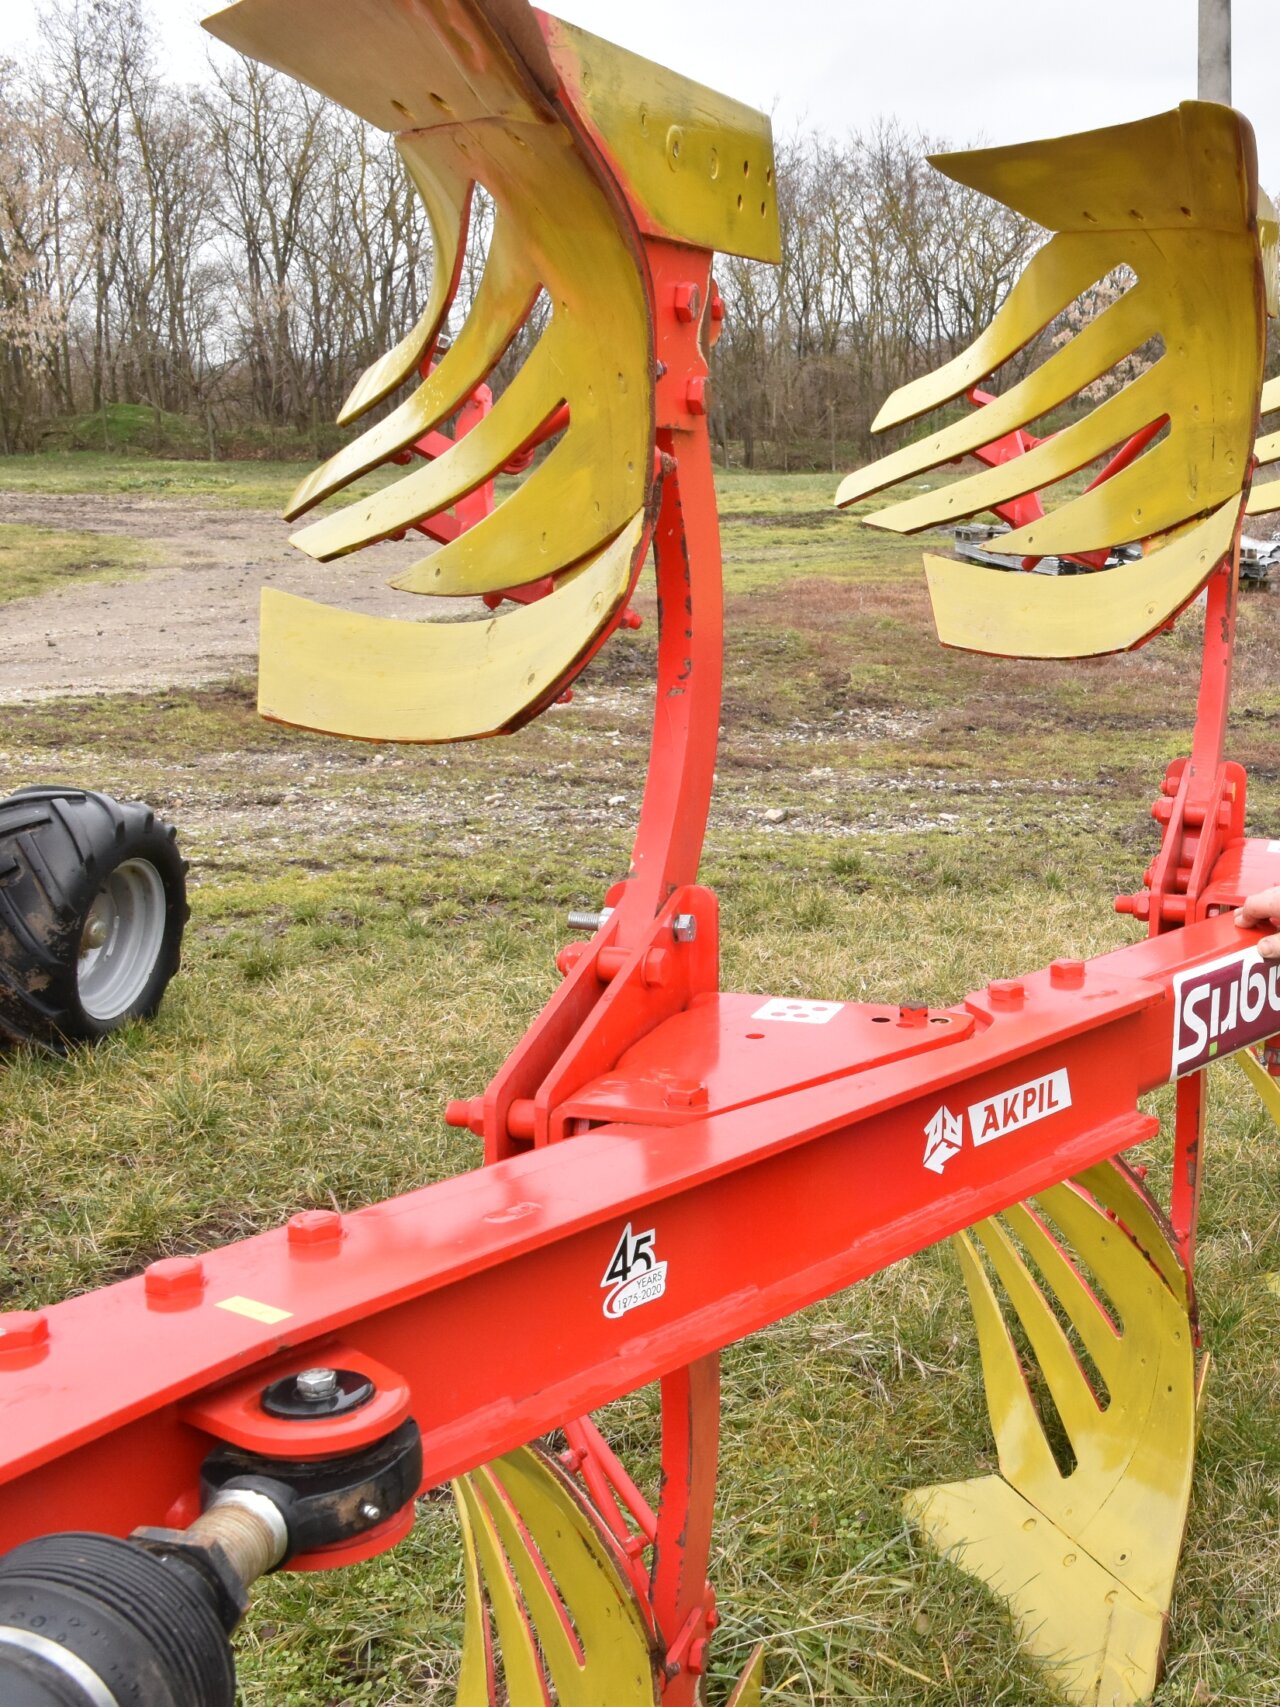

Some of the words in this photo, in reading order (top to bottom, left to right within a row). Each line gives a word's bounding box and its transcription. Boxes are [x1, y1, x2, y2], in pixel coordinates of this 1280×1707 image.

[980, 1079, 1059, 1138] AKPIL
[605, 1232, 652, 1282] 45
[618, 1283, 662, 1310] 1975-2020
[636, 1271, 663, 1289] YEARS
